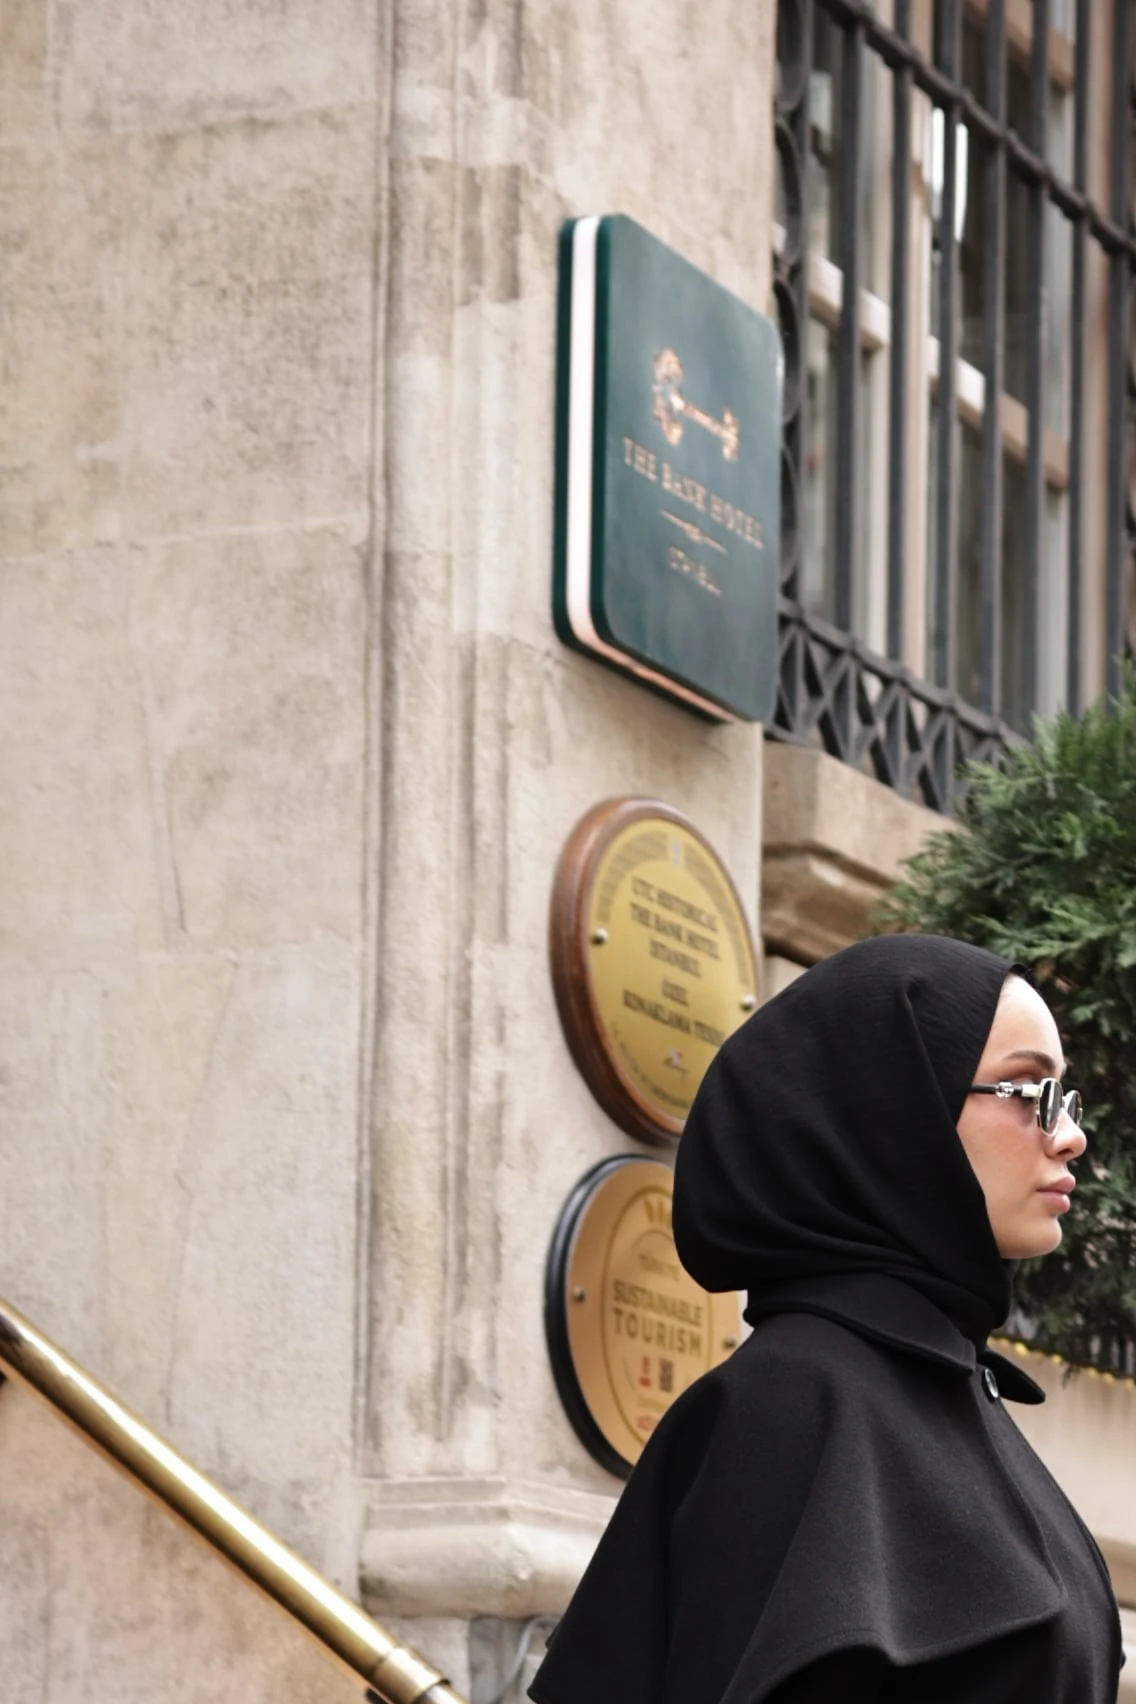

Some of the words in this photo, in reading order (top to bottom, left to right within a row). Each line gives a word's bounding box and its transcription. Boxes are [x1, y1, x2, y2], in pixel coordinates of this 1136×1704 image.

[624, 435, 657, 481] THE
[662, 461, 707, 512] BANK
[711, 493, 763, 549] HOTEL
[612, 1279, 704, 1328] SUSTAINABLE
[612, 1306, 703, 1359] TOURISM
